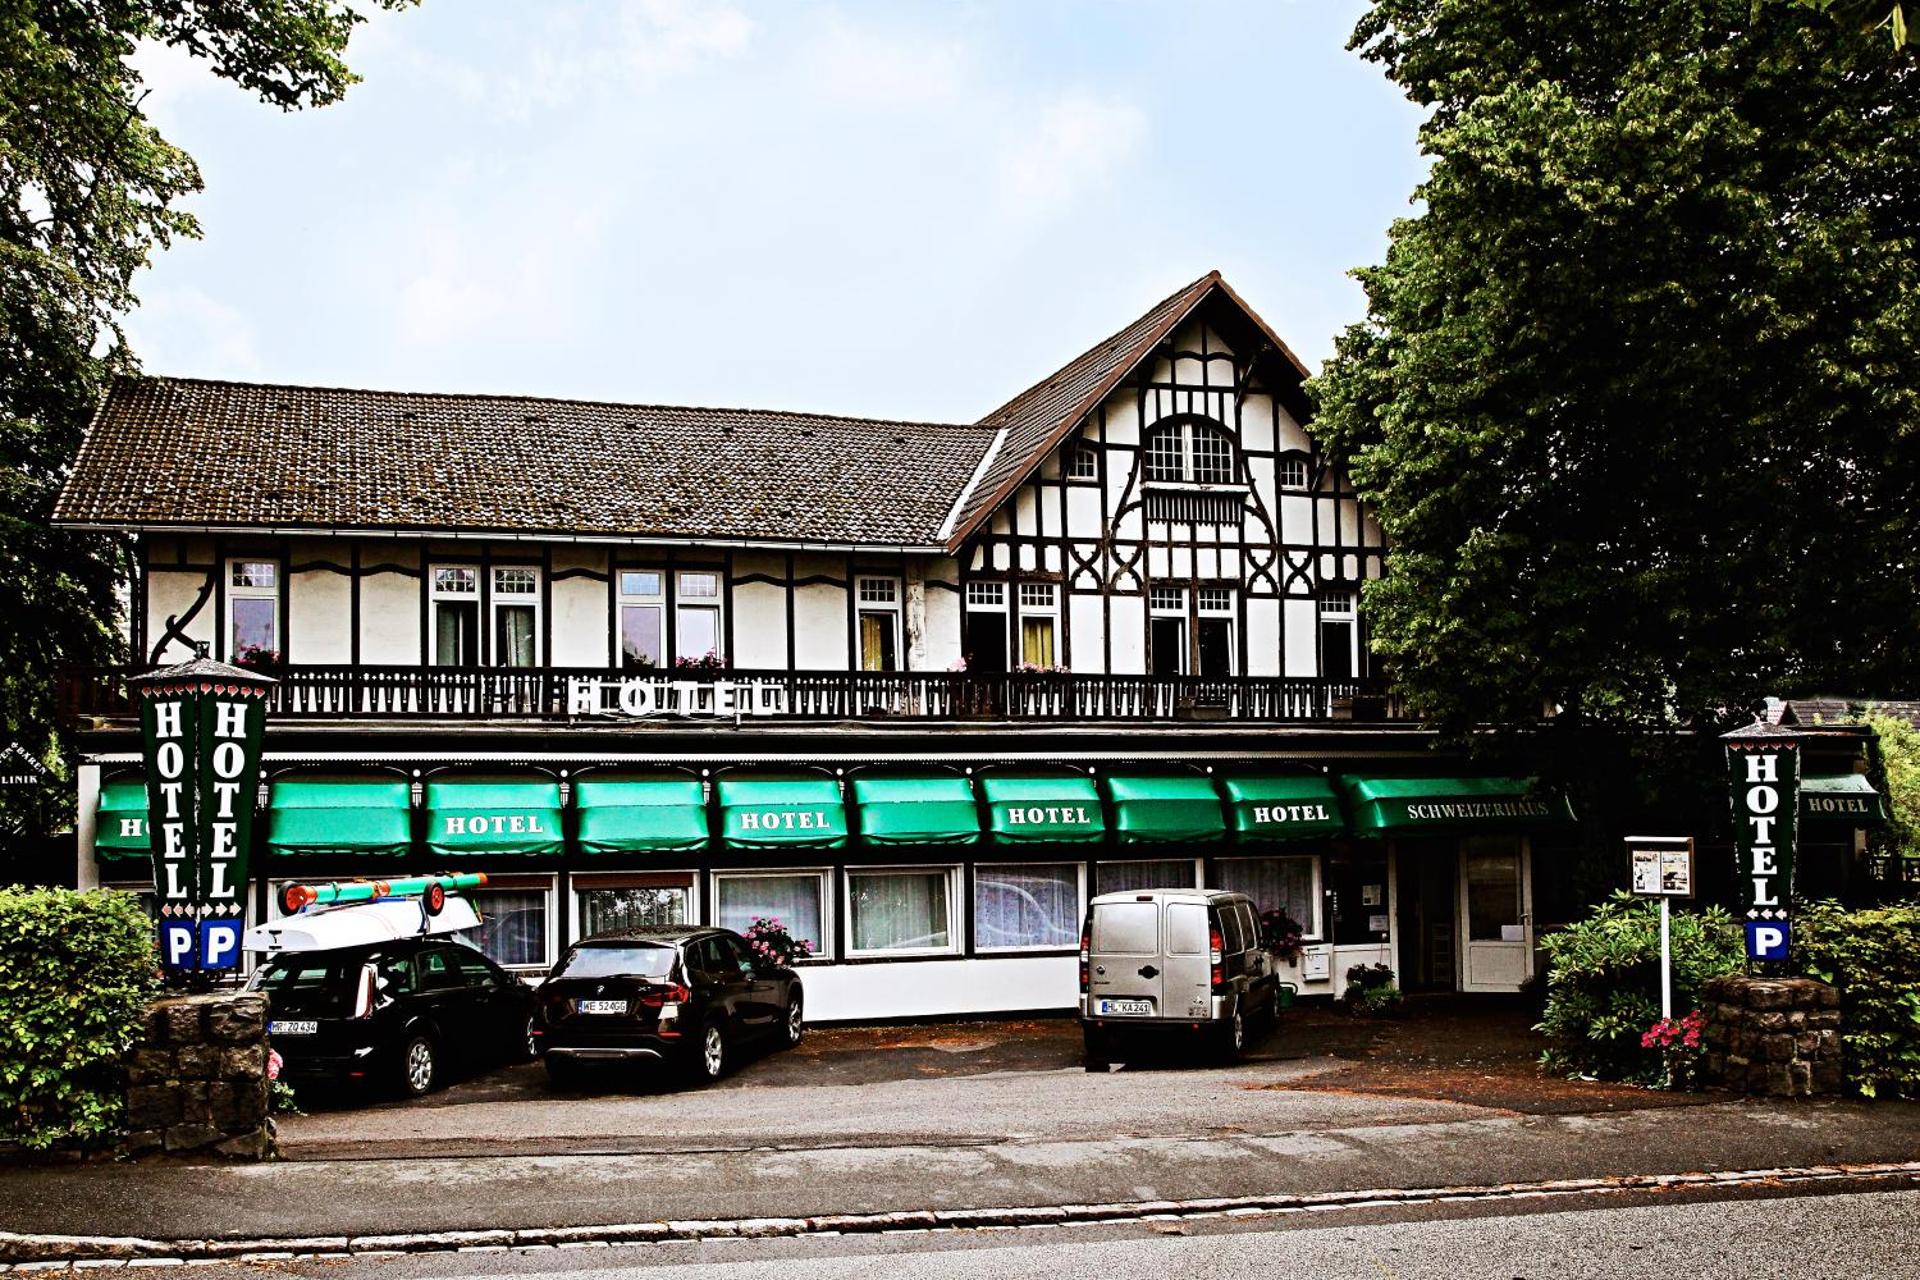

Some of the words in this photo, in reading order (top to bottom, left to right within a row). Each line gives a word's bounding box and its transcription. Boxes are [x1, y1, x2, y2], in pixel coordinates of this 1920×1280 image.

[568, 680, 774, 716] HOTEL
[155, 702, 187, 899] HOTEL
[210, 702, 247, 898] HOTEL
[1253, 805, 1329, 822] HOTEL
[1407, 801, 1549, 819] SCHWEIZERHAUS
[1808, 798, 1868, 813] HOTEL
[446, 815, 544, 834] HOTEL
[741, 811, 830, 829] HOTEL
[1008, 806, 1090, 824] HOTEL
[1745, 755, 1779, 906] HOTEL
[170, 927, 192, 965] P
[208, 926, 236, 964] P
[1755, 927, 1783, 956] P
